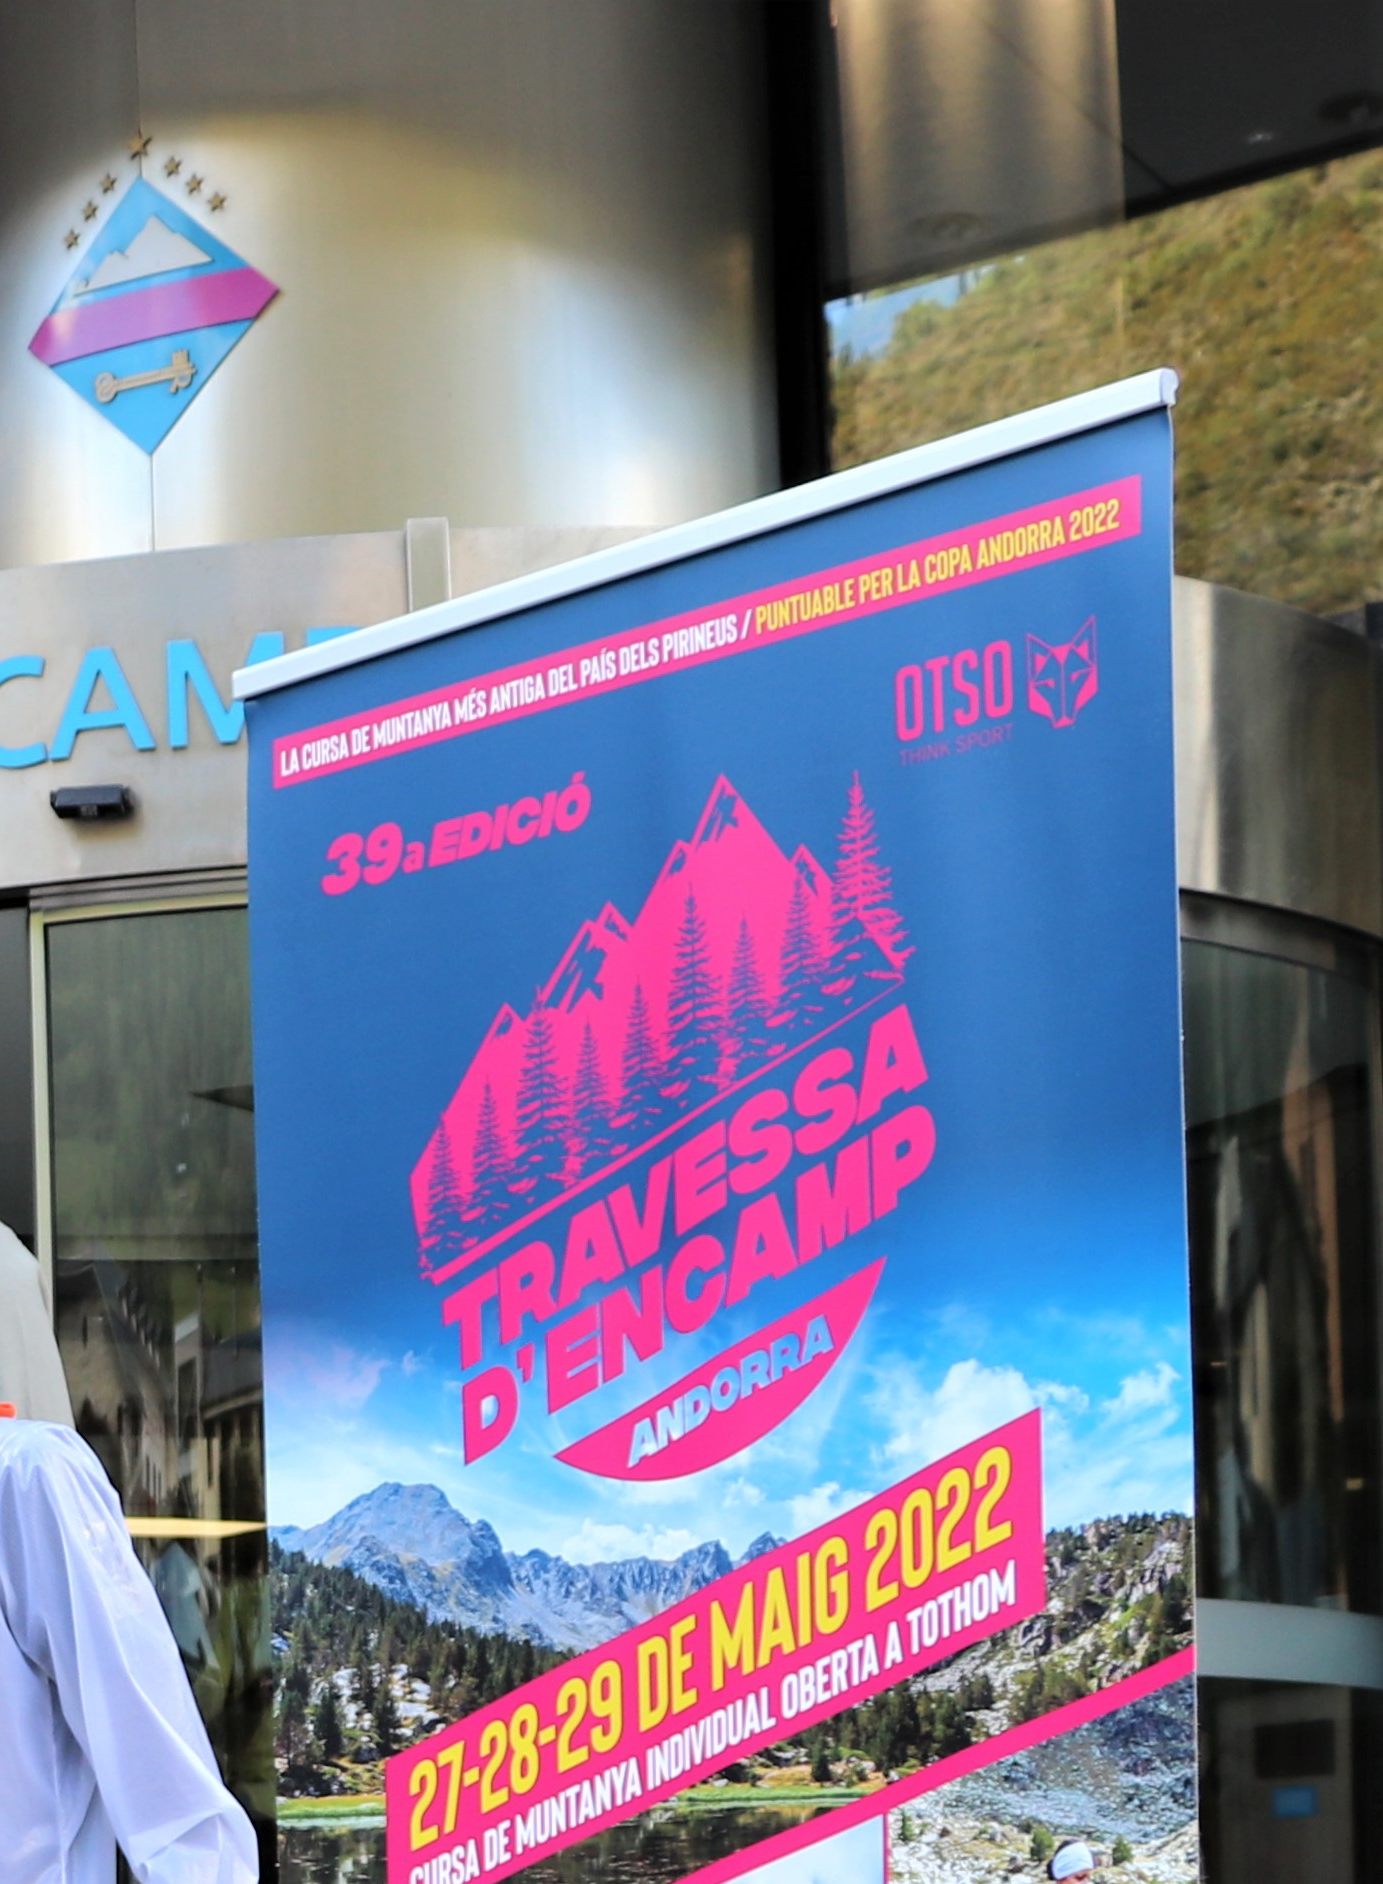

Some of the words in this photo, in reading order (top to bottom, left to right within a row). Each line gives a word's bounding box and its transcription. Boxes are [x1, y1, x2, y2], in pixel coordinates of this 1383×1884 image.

[281, 743, 300, 777] LA
[302, 730, 350, 771] CURSA
[351, 724, 371, 757] DE
[373, 703, 452, 750] MUNTANYA
[454, 688, 488, 726] MÉS
[489, 674, 546, 715] ANTIGA
[548, 661, 578, 698] DEL
[580, 647, 617, 688] PAÍS
[619, 637, 660, 676] DELS
[662, 613, 738, 663] PIRINEUS
[755, 579, 855, 633] PUNTUABLE
[858, 567, 893, 604] PER
[897, 560, 921, 593] LA
[924, 544, 973, 584] COPA
[976, 515, 1065, 570] ANDORRA
[1069, 498, 1121, 541] 2022
[895, 640, 1013, 741] OTSO
[898, 739, 950, 766] THINK
[954, 722, 1013, 754] SPORT
[428, 771, 591, 868] EDICIÓ
[441, 1003, 929, 1371] TRAVESSA
[462, 1105, 936, 1465] D'ENCAMP
[627, 1314, 834, 1468] ANDORRA
[409, 1659, 622, 1852] 27-28-29
[638, 1616, 697, 1733] DE
[710, 1535, 849, 1691] MAIG
[864, 1445, 1013, 1612] 2022
[484, 1822, 512, 1871] DE
[515, 1757, 644, 1853] MUNTANYA
[647, 1692, 776, 1789] INDIVIDUAL
[781, 1635, 879, 1720] OBERTA
[884, 1621, 903, 1670] A
[908, 1560, 1016, 1657] TOTHOM
